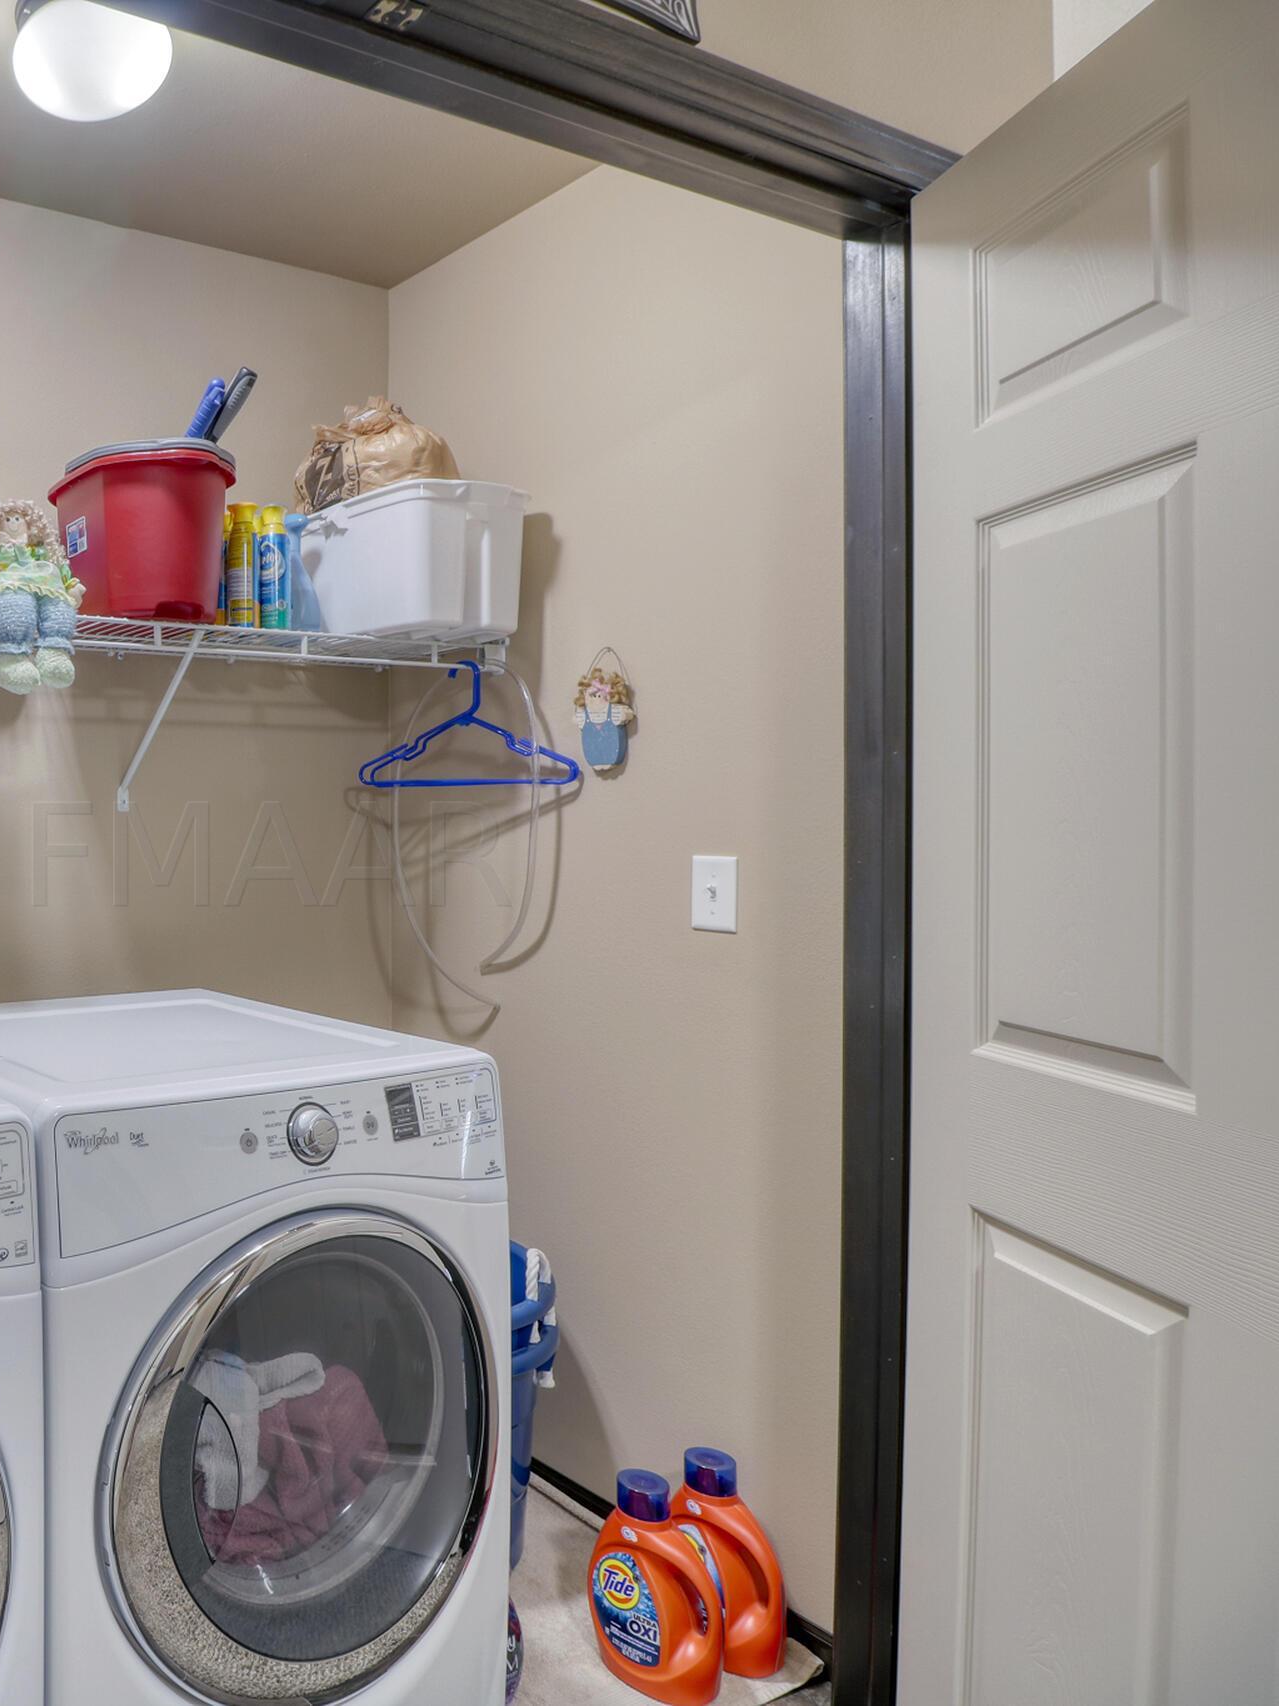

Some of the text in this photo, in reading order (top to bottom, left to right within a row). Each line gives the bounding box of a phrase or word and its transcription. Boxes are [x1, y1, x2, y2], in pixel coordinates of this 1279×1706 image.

[66, 1131, 119, 1150] Whirlpool
[603, 1567, 635, 1597] Tide
[628, 1620, 658, 1643] OXI
[632, 1613, 657, 1629] ULTRA
